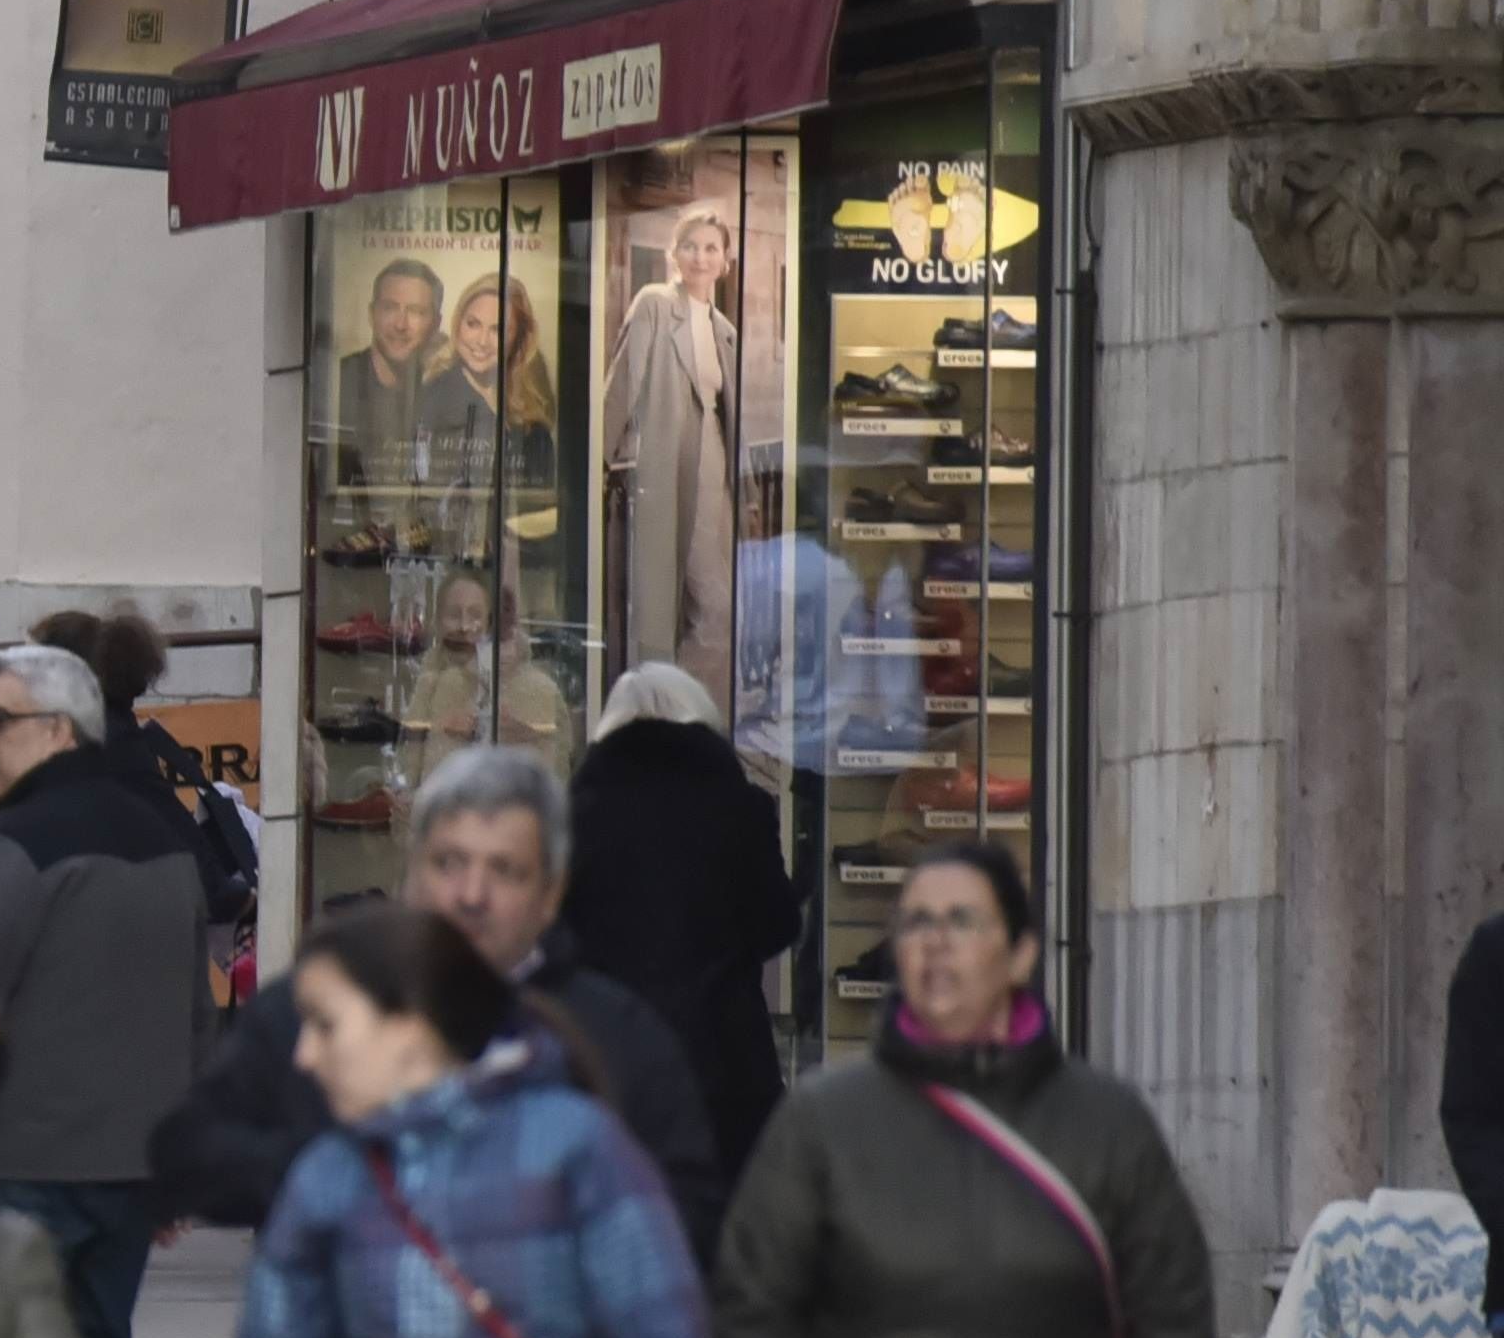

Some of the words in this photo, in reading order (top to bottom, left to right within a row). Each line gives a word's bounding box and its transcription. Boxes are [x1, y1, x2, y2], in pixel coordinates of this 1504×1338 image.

[65, 106, 170, 132] ASOCIA
[402, 57, 534, 179] MUÑOZ
[899, 161, 931, 180] NO
[937, 161, 985, 178] PAIN
[362, 206, 502, 234] MEPHISTO
[872, 258, 909, 283] NO
[847, 421, 887, 432] crocs
[932, 470, 972, 481] crocs
[928, 584, 968, 595] crocs
